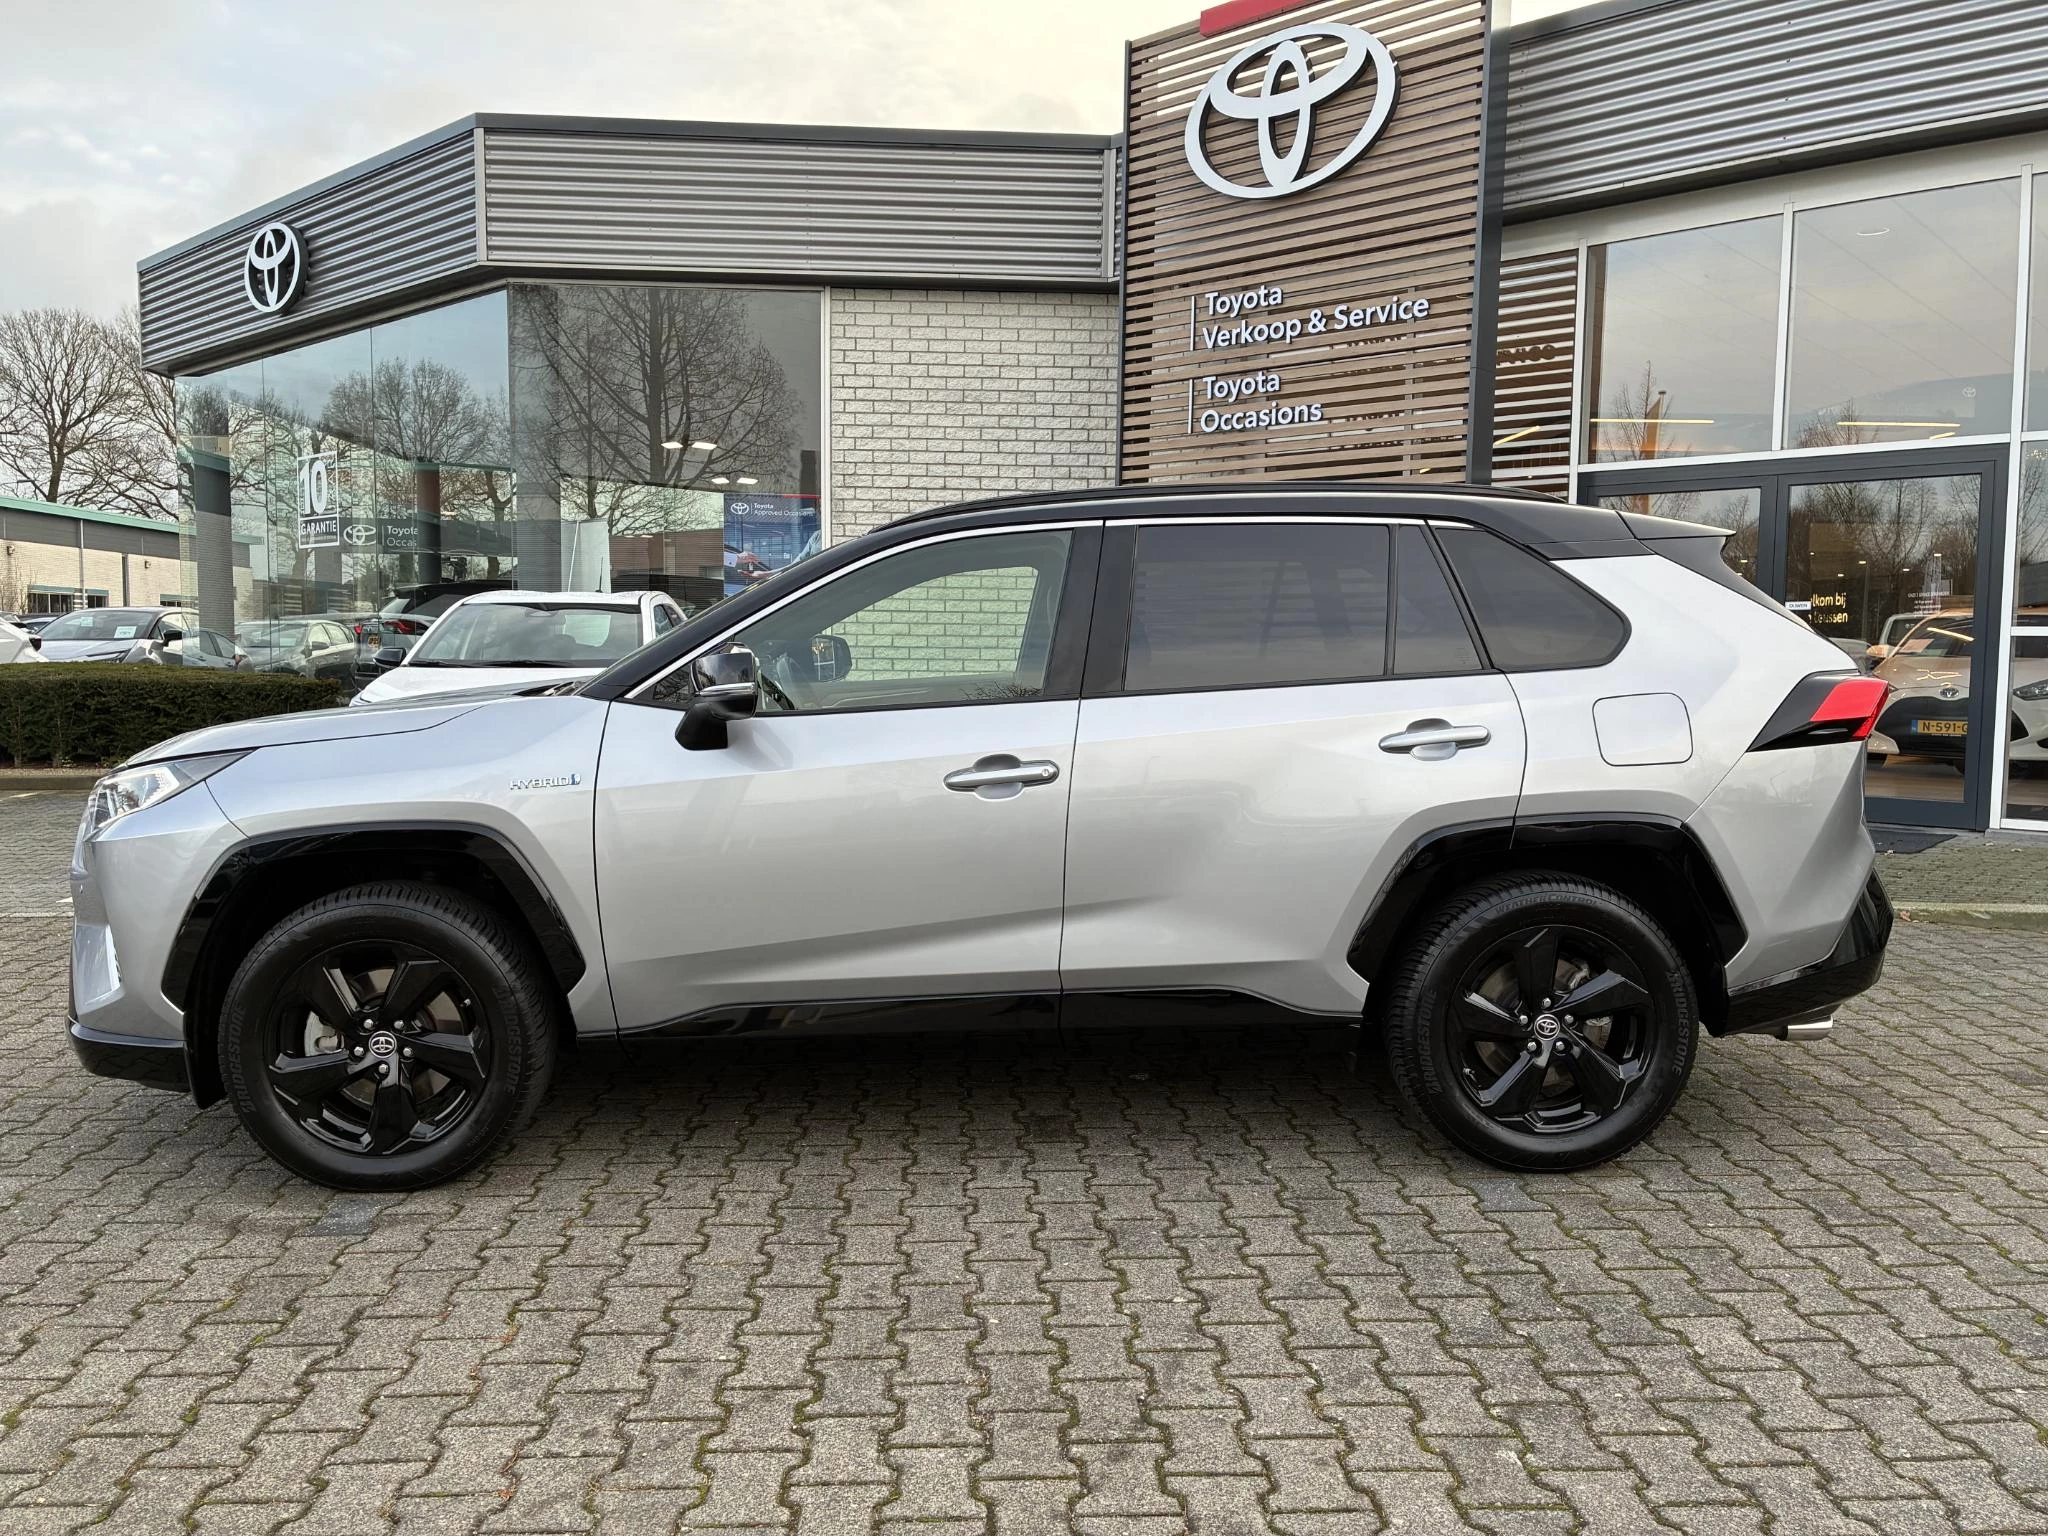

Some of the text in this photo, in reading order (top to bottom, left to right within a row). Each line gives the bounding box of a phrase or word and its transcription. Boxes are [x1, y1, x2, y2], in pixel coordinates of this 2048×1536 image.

[1205, 285, 1283, 318] Toyota
[1202, 296, 1429, 349] Verkoop & Service
[1203, 371, 1281, 403] Toyota
[1200, 401, 1322, 433] Occasions
[300, 459, 328, 515] 10
[301, 520, 337, 535] GARANTIE
[753, 509, 782, 517] Approved
[1811, 592, 1847, 609] lkom bij
[510, 776, 570, 790] HYBRID
